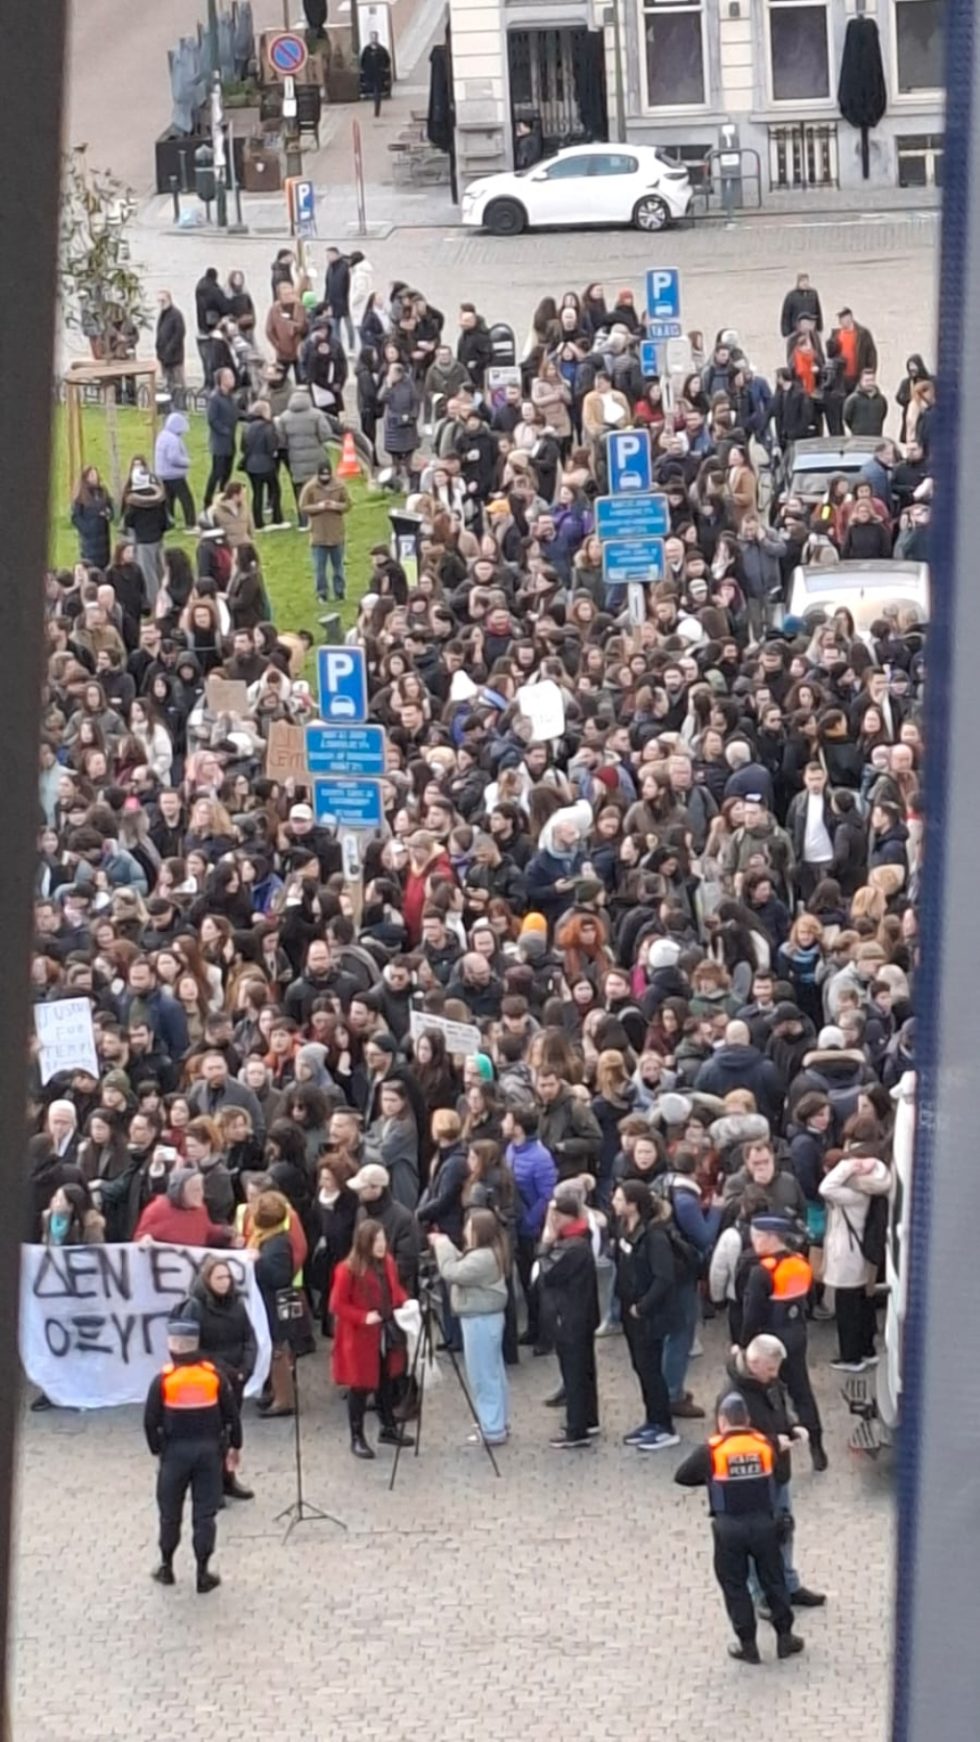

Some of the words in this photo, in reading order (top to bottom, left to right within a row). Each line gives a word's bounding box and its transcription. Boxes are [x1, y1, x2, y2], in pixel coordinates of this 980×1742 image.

[299, 184, 310, 207] P
[652, 272, 672, 300] P
[616, 436, 640, 469] P
[327, 653, 354, 692] P
[33, 1248, 131, 1300] ΔΕΝ
